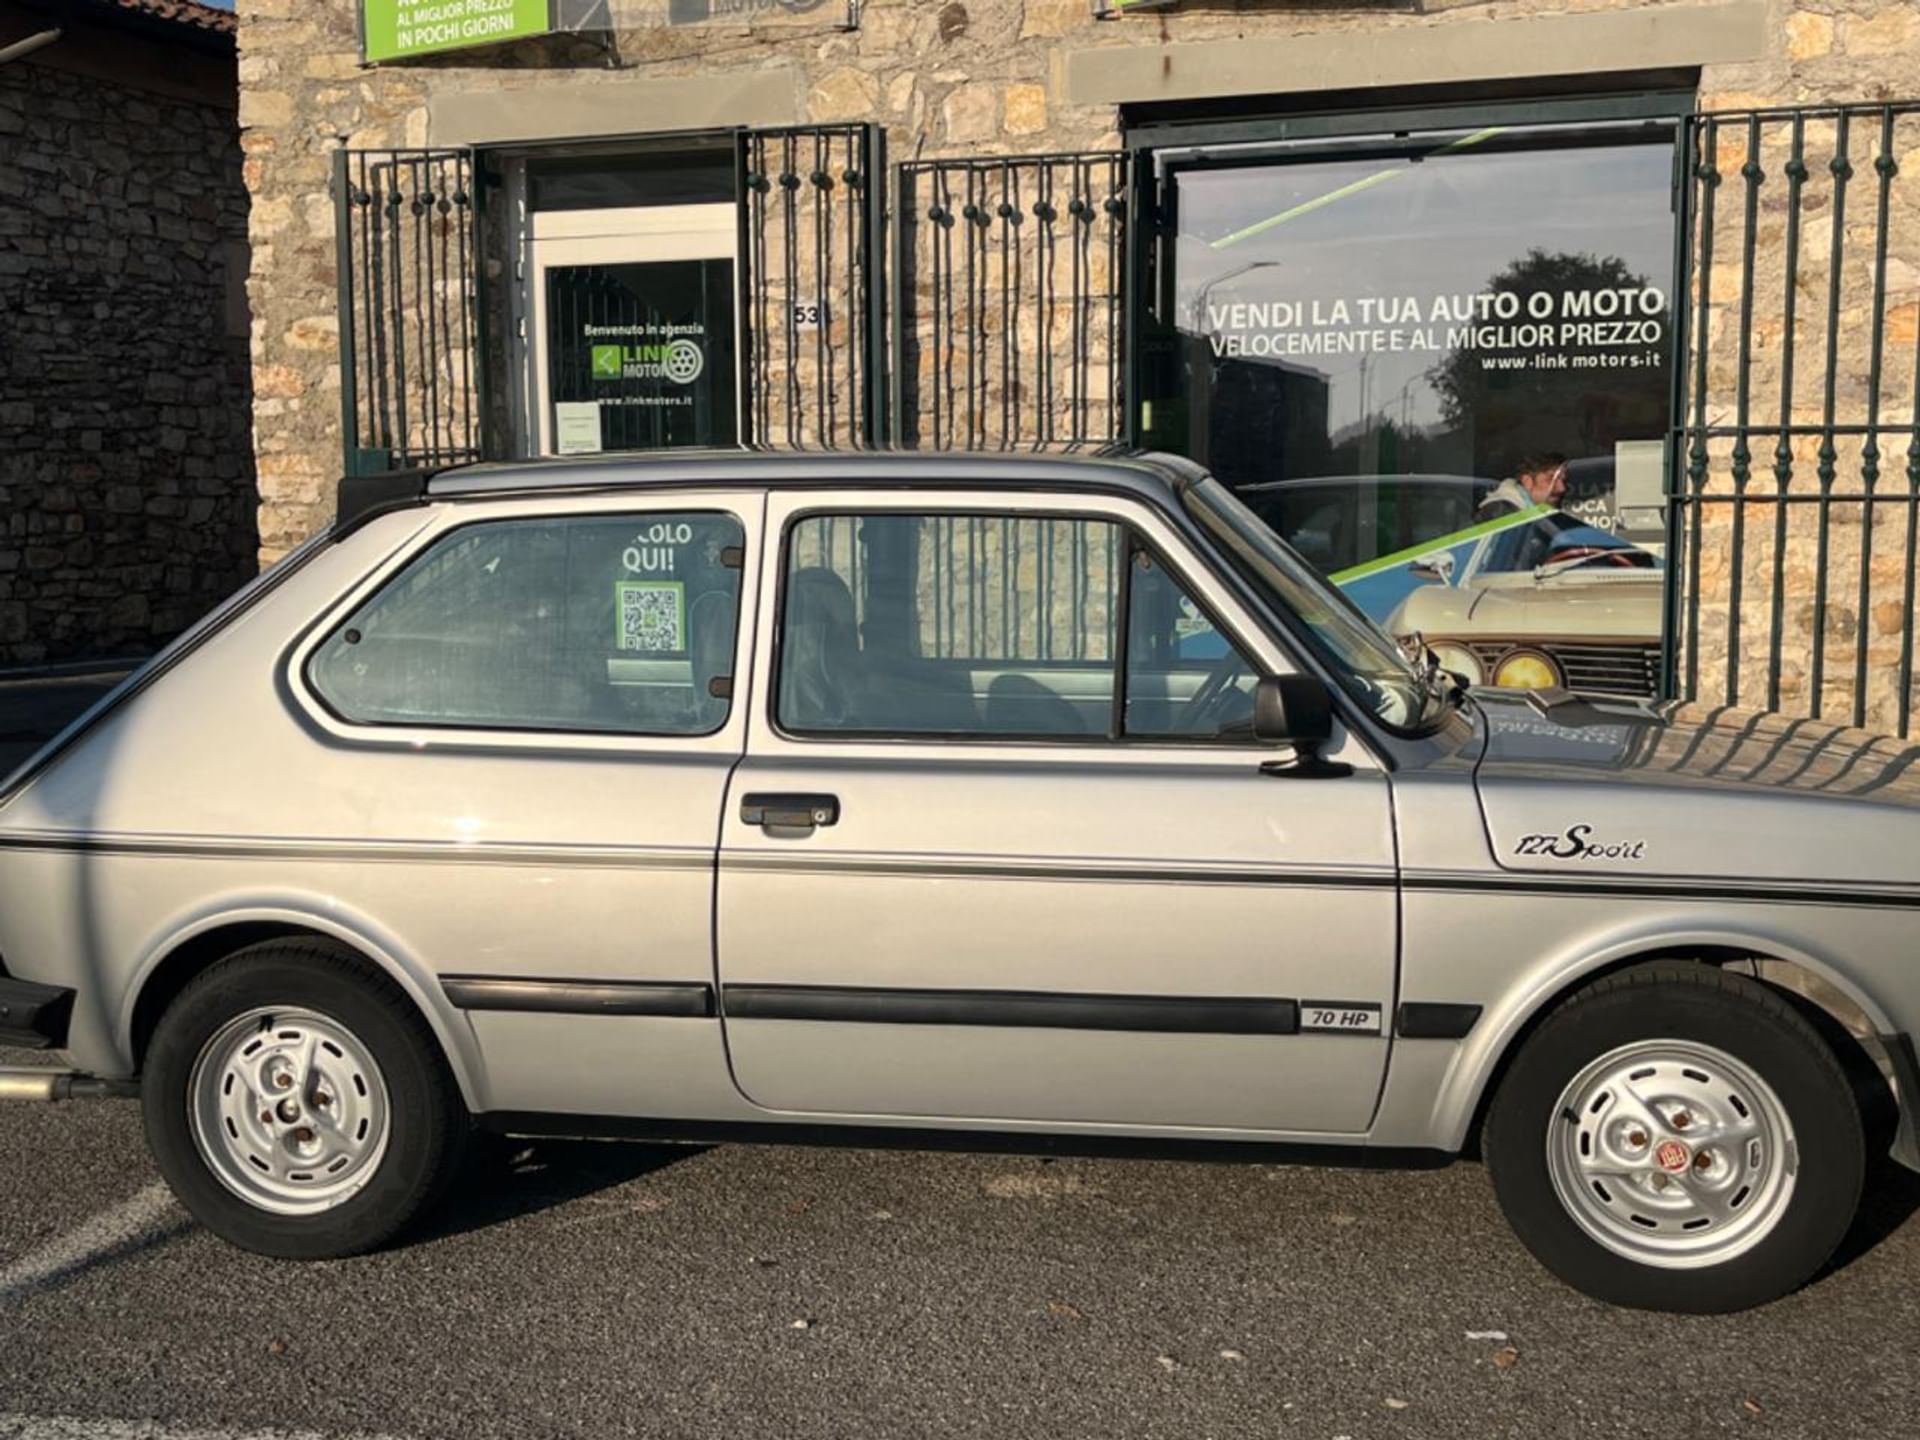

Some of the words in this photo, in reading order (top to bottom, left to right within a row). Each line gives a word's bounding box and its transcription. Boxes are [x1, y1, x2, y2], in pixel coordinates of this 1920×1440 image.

[397, 13, 412, 27] AL
[413, 5, 464, 23] MIGLIOR
[466, 0, 513, 14] PREZZO
[397, 30, 412, 49] IN
[415, 23, 460, 45] POCHI
[462, 14, 515, 38] GIORNI
[1208, 301, 1302, 330] VENDI
[1312, 299, 1351, 326] LA
[1357, 297, 1421, 324] TUA
[1430, 291, 1519, 322] AUTO
[1528, 291, 1554, 319] O
[1561, 287, 1665, 318] MOTO
[584, 323, 644, 336] Benvenuto
[646, 322, 658, 335] in
[659, 322, 704, 338] agenzia
[1209, 330, 1385, 357] VELOCEMENTE
[1410, 327, 1441, 350] AL
[1446, 324, 1554, 349] MIGLIOR
[1560, 320, 1662, 346] PREZZO
[622, 547, 674, 573] QUI!
[1313, 1010, 1335, 1025] 70
[1340, 1012, 1369, 1026] HP
